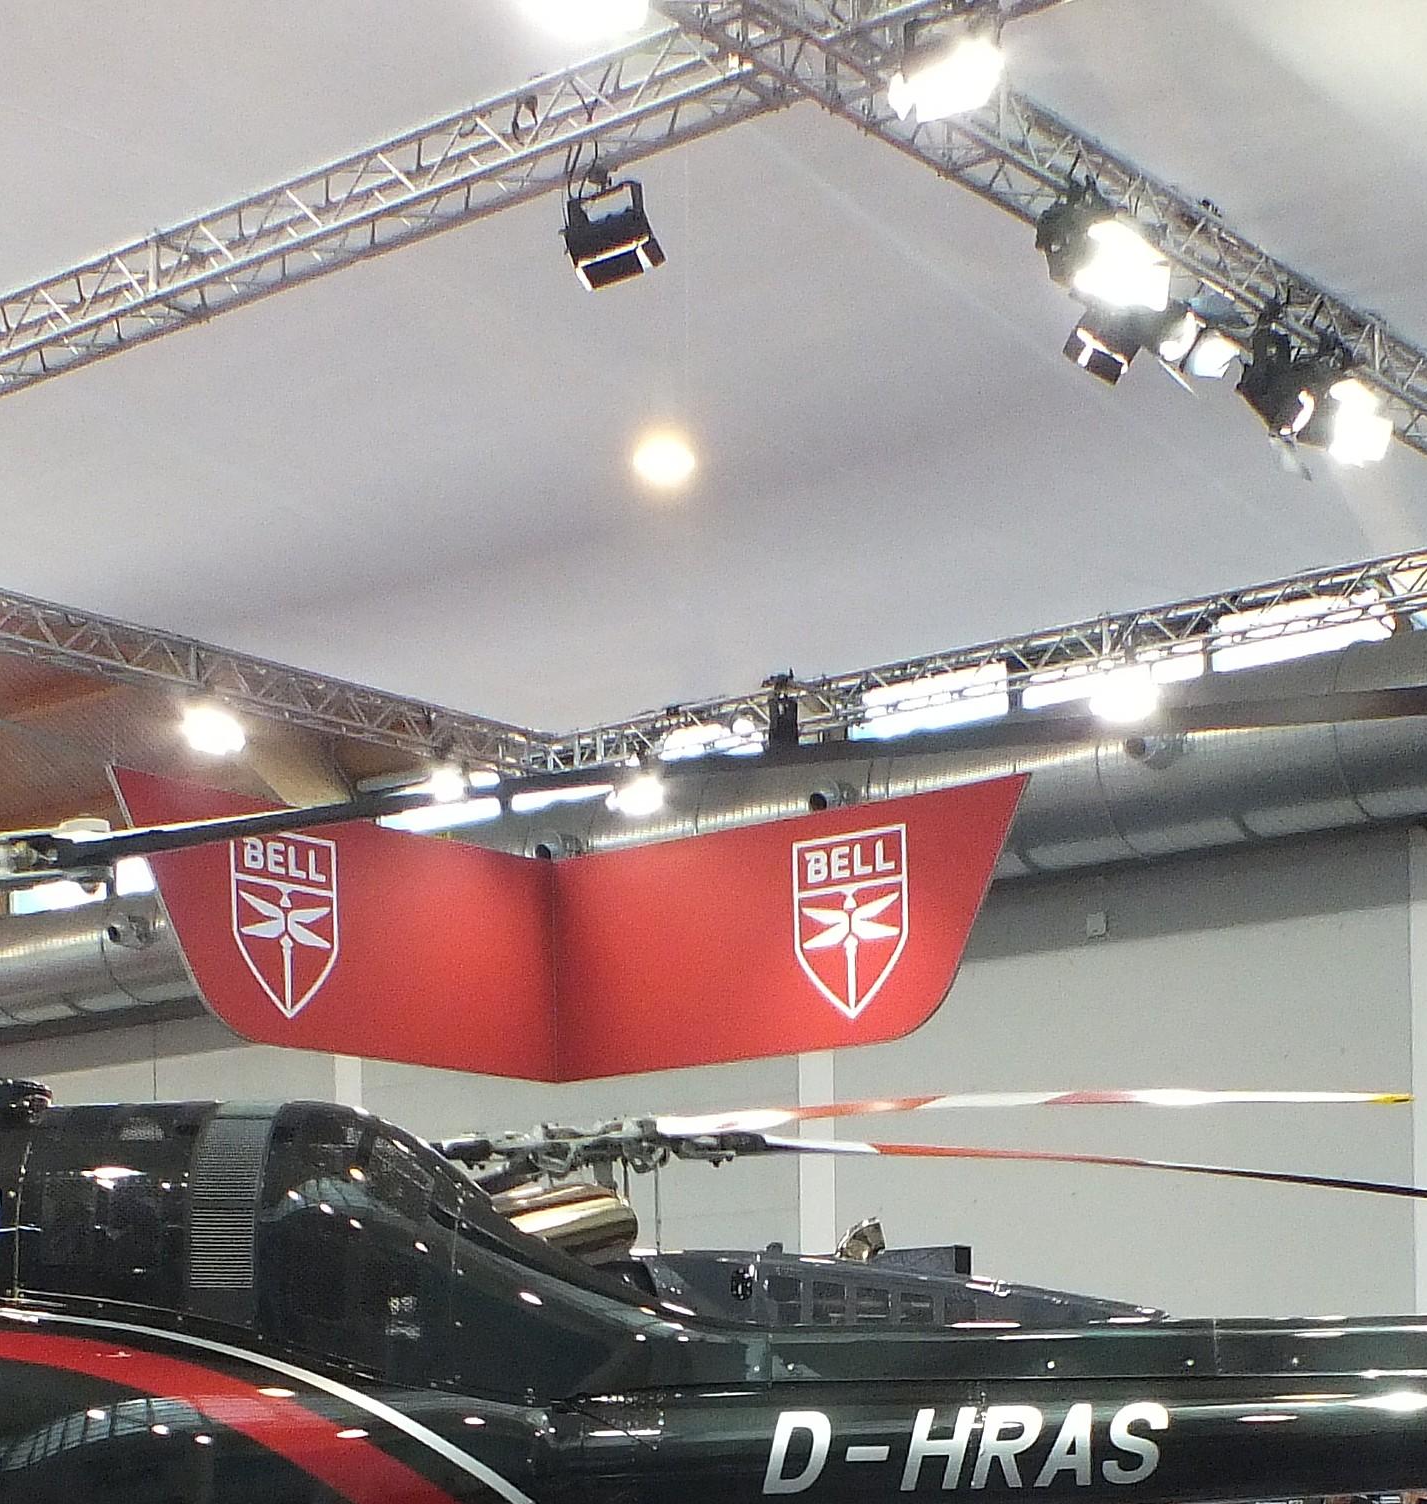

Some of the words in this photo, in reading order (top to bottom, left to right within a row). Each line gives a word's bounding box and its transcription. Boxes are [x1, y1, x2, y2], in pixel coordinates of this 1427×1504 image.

[243, 837, 326, 883] BELL
[804, 839, 895, 884] BELL
[762, 1402, 1170, 1495] D-HRAS
